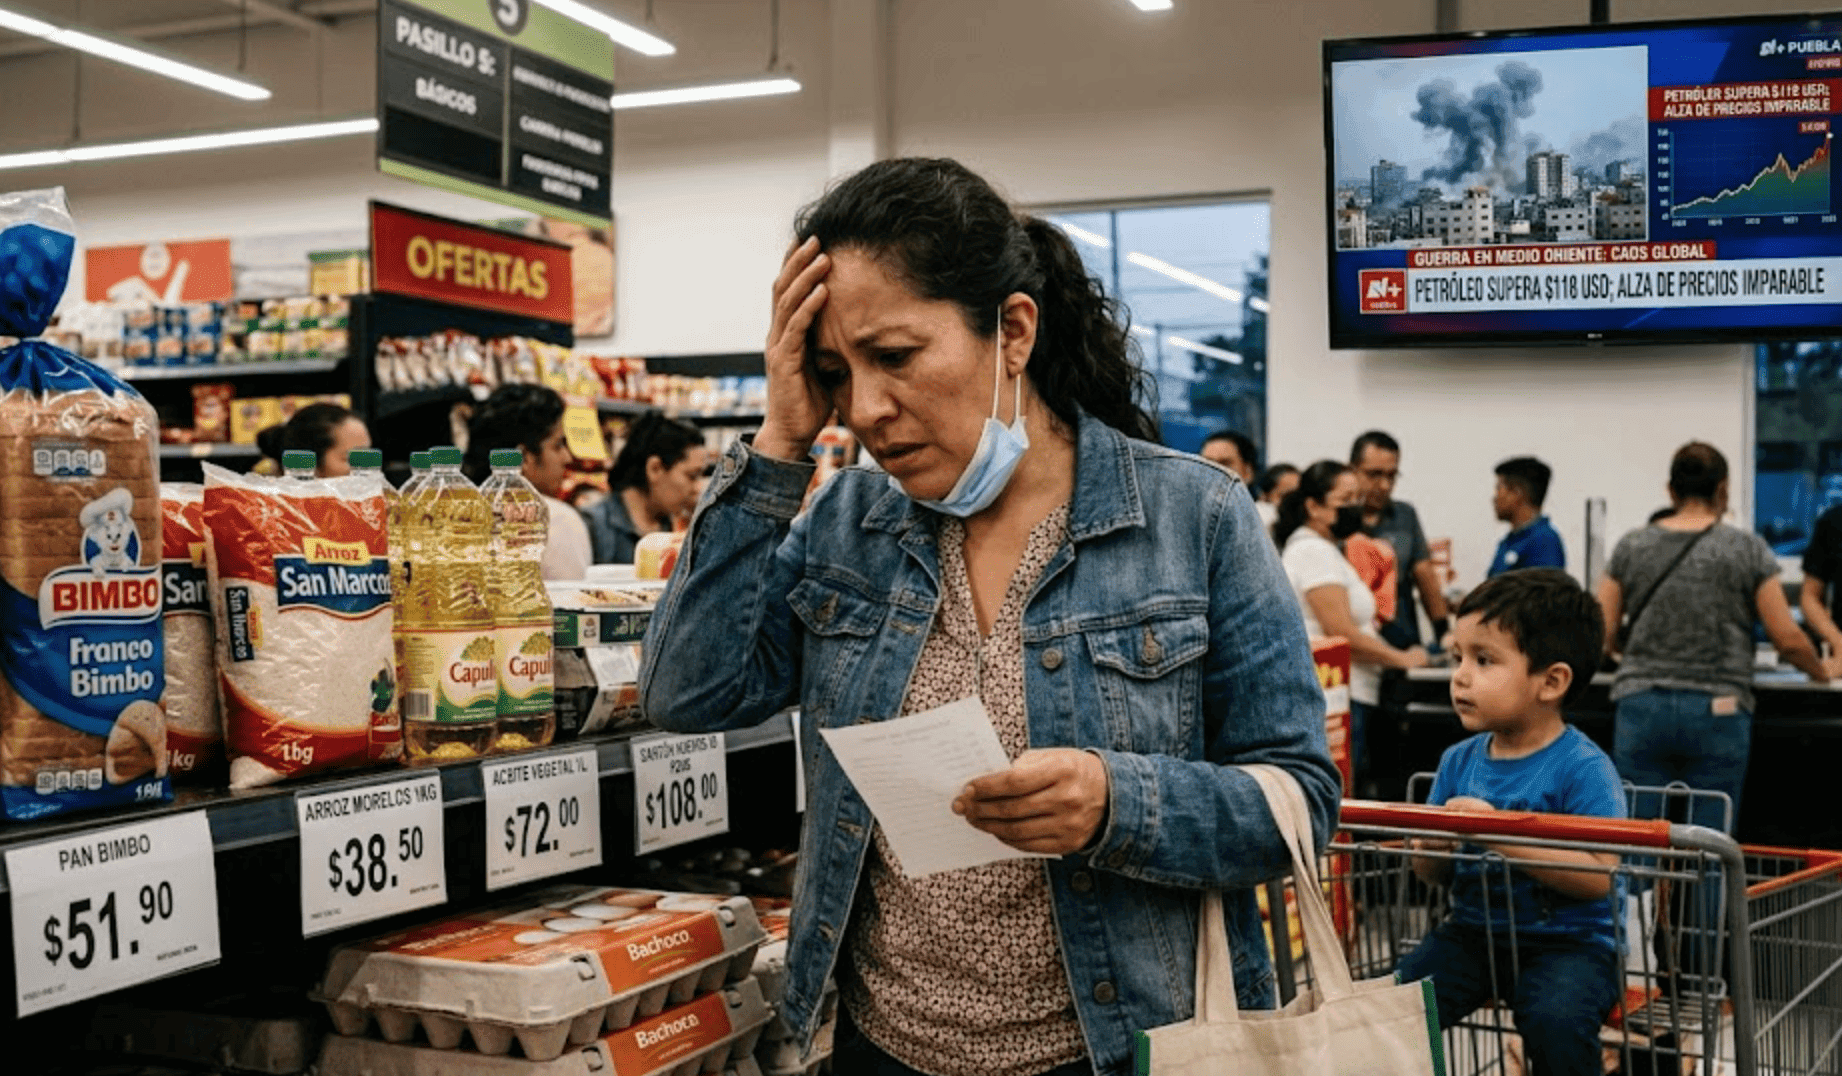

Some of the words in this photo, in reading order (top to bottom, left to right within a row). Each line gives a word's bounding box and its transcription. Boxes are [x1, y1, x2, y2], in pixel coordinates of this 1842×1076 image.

[395, 16, 476, 68] PASILLO
[1787, 39, 1842, 53] PUEBLA
[415, 77, 477, 116] BÁSICOS
[1695, 103, 1711, 117] DE
[406, 235, 549, 299] OFERTAS
[1414, 250, 1471, 267] GUERRA
[1496, 248, 1541, 264] MEDIO
[1611, 245, 1649, 261] CAOS
[1652, 243, 1708, 260] GLOBAL
[1415, 271, 1483, 302] PETRÓLEO
[1487, 275, 1541, 301] SUPERA
[1545, 274, 1578, 303] $118
[1617, 271, 1653, 298] ALZA
[1657, 271, 1675, 297] DE
[1679, 269, 1738, 296] PRECIOS
[1743, 267, 1825, 295] IMPARABLE
[314, 544, 361, 562] Arroz
[53, 578, 159, 612] BIMBO
[281, 566, 327, 598] San
[69, 637, 153, 666] Franco
[70, 664, 154, 698] Bimbo
[305, 797, 350, 822] ARROZ
[59, 845, 93, 871] PAN
[98, 834, 150, 864] BIMBO
[627, 929, 690, 962] Bachoco
[635, 1013, 700, 1049] Bachoco
